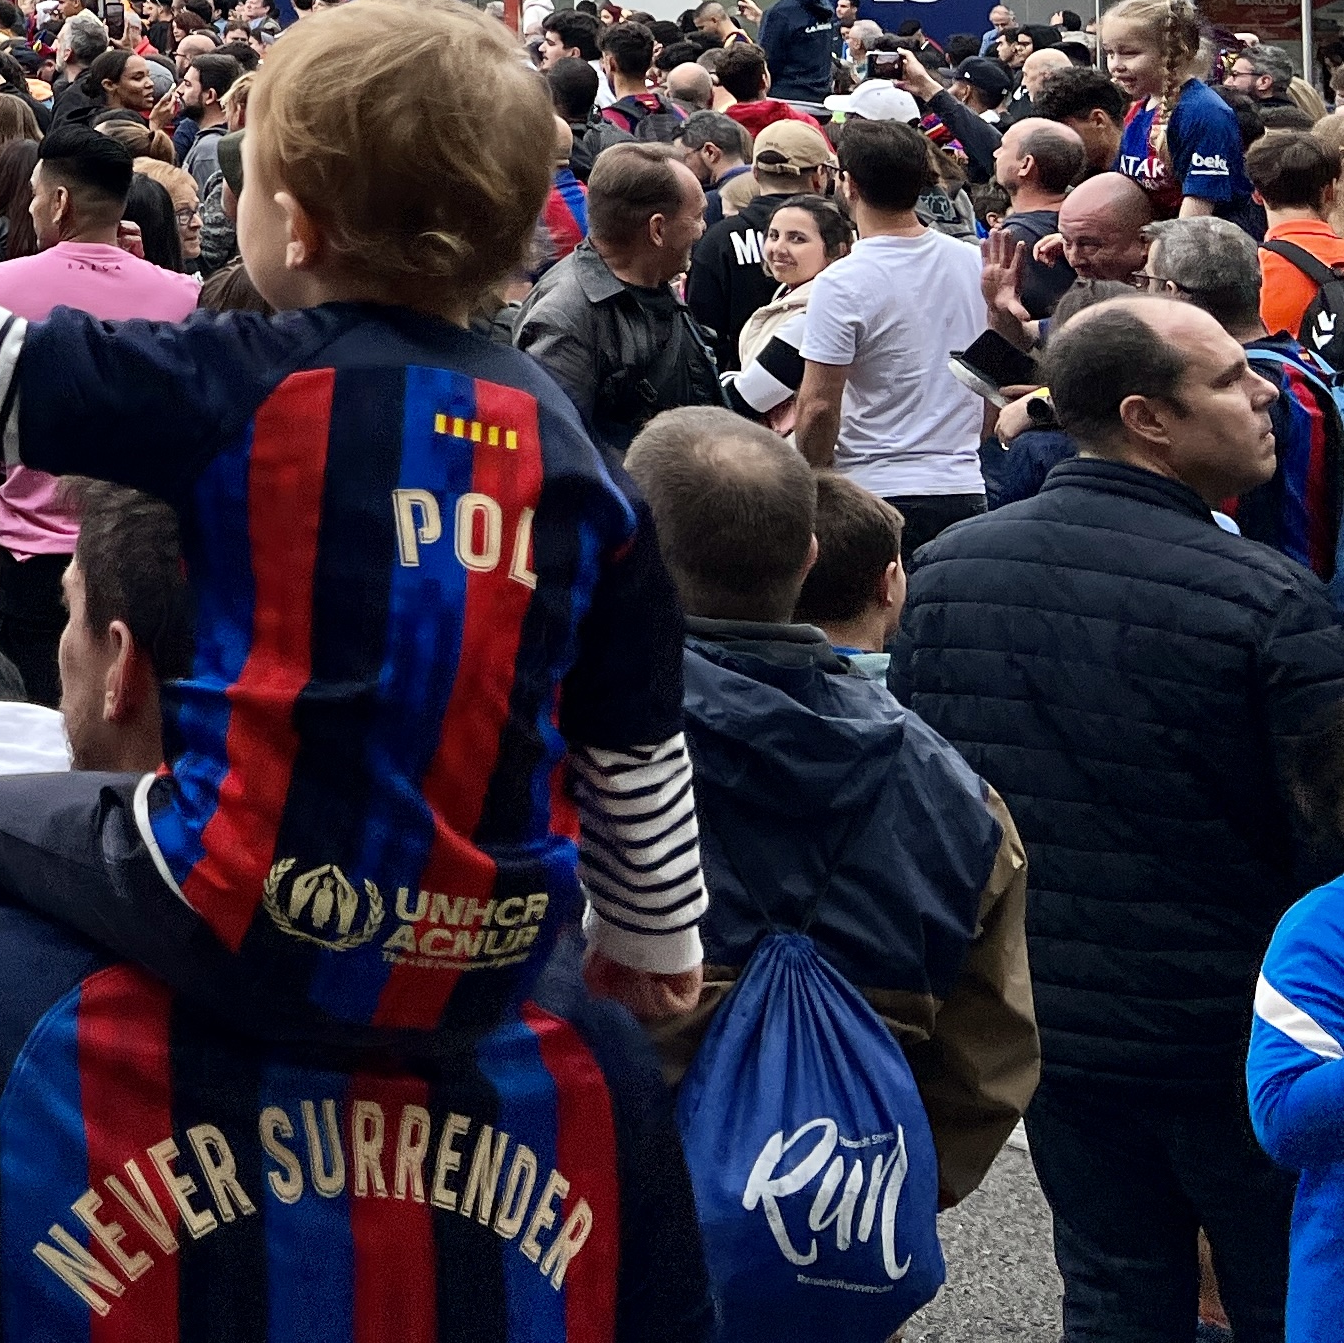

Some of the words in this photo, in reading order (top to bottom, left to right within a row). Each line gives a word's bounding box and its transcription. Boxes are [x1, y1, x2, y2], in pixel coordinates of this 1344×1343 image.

[1119, 154, 1165, 179] ATAR
[392, 488, 538, 590] POL
[382, 923, 540, 958] ACNUR
[395, 883, 549, 928] UNHCR
[32, 1122, 257, 1318] NEVER
[258, 1098, 594, 1292] SURRENDER
[741, 1117, 912, 1280] Run
